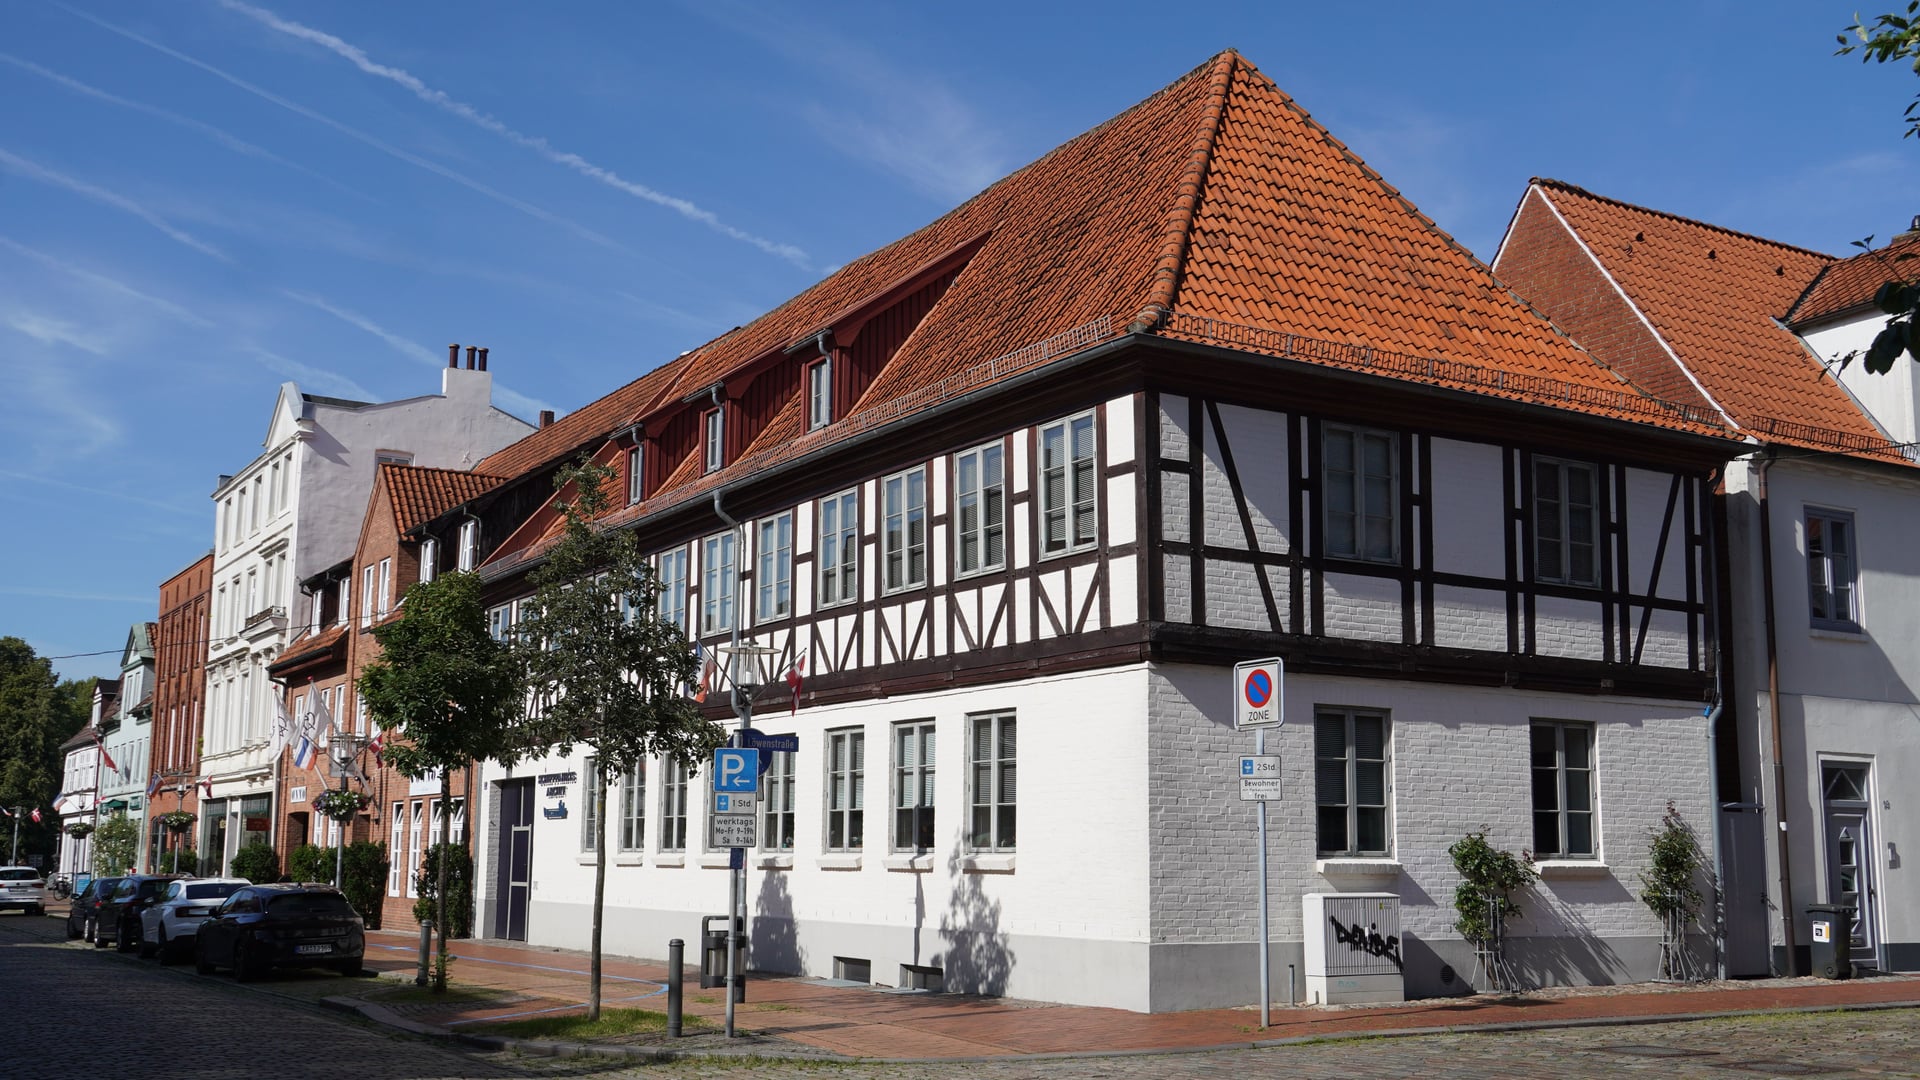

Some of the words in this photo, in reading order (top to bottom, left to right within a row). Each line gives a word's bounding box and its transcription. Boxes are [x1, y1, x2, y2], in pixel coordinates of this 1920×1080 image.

[1248, 709, 1270, 722] ZONE
[747, 737, 795, 749] Löwenstraße
[722, 754, 745, 786] P
[1244, 779, 1279, 787] Bewohner
[737, 799, 753, 808] Std.
[716, 817, 754, 826] werktags
[715, 826, 734, 835] Mo-Fr
[736, 826, 754, 835] 9-19h
[736, 836, 754, 845] 9-14h
